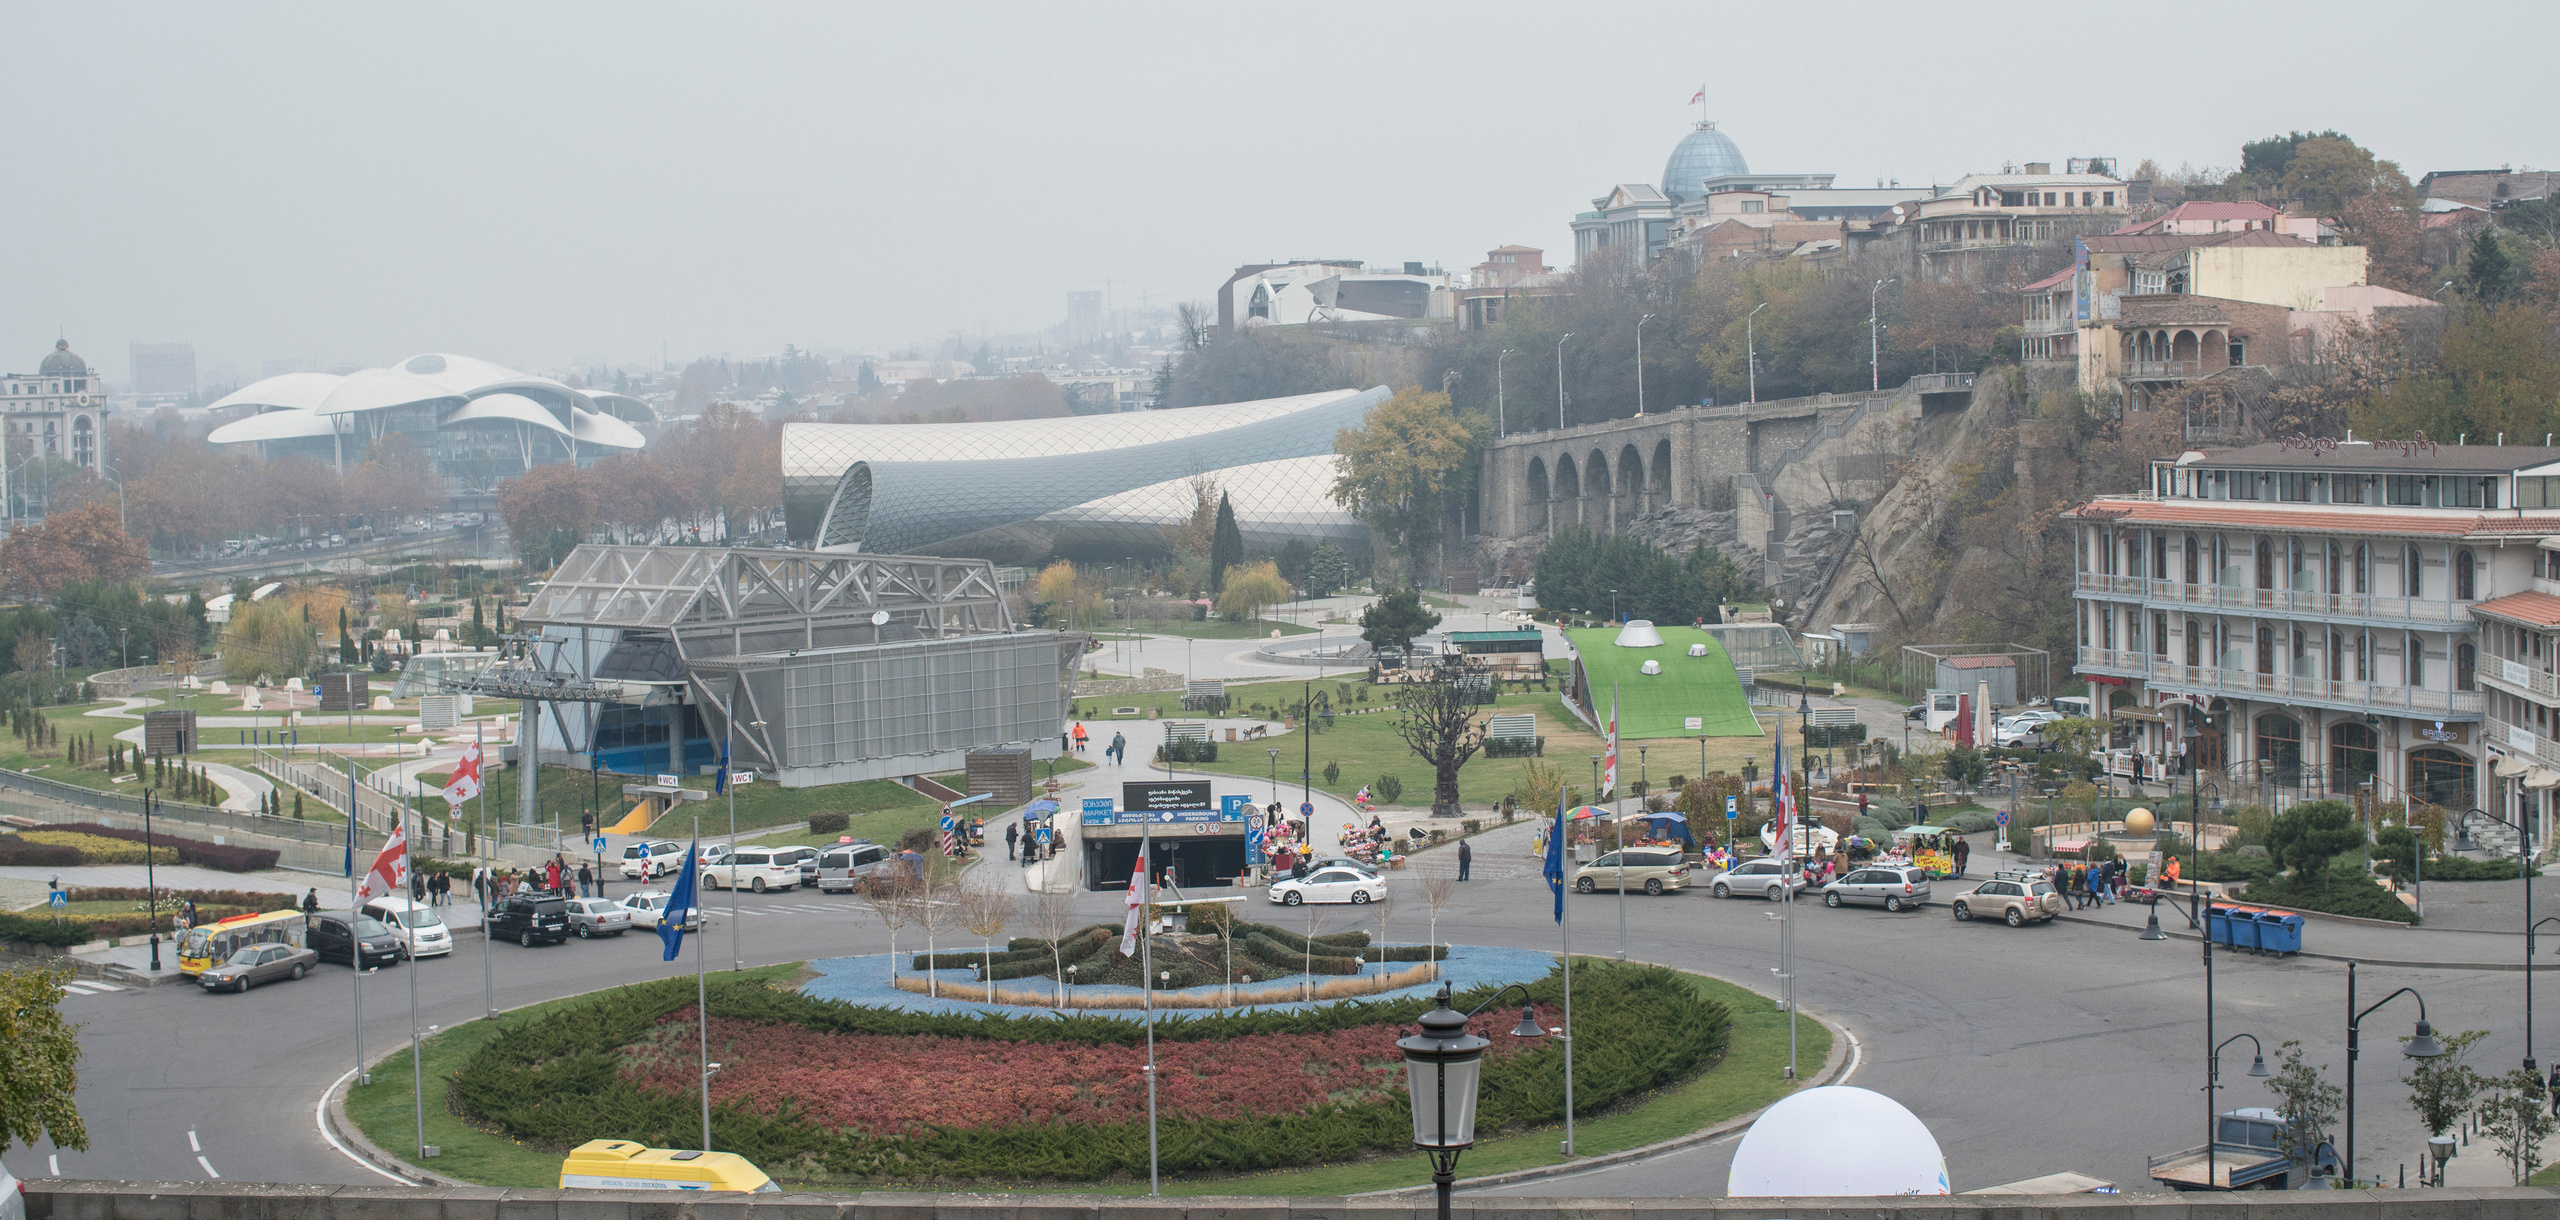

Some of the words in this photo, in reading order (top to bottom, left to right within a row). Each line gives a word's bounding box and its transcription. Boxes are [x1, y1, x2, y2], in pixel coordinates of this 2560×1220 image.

[2159, 692, 2179, 703] HOTEL
[2422, 728, 2458, 740] BAMBOO
[662, 776, 673, 785] WC
[735, 774, 748, 783] WC
[1083, 800, 1112, 808] მარკეტი
[1232, 799, 1242, 810] P
